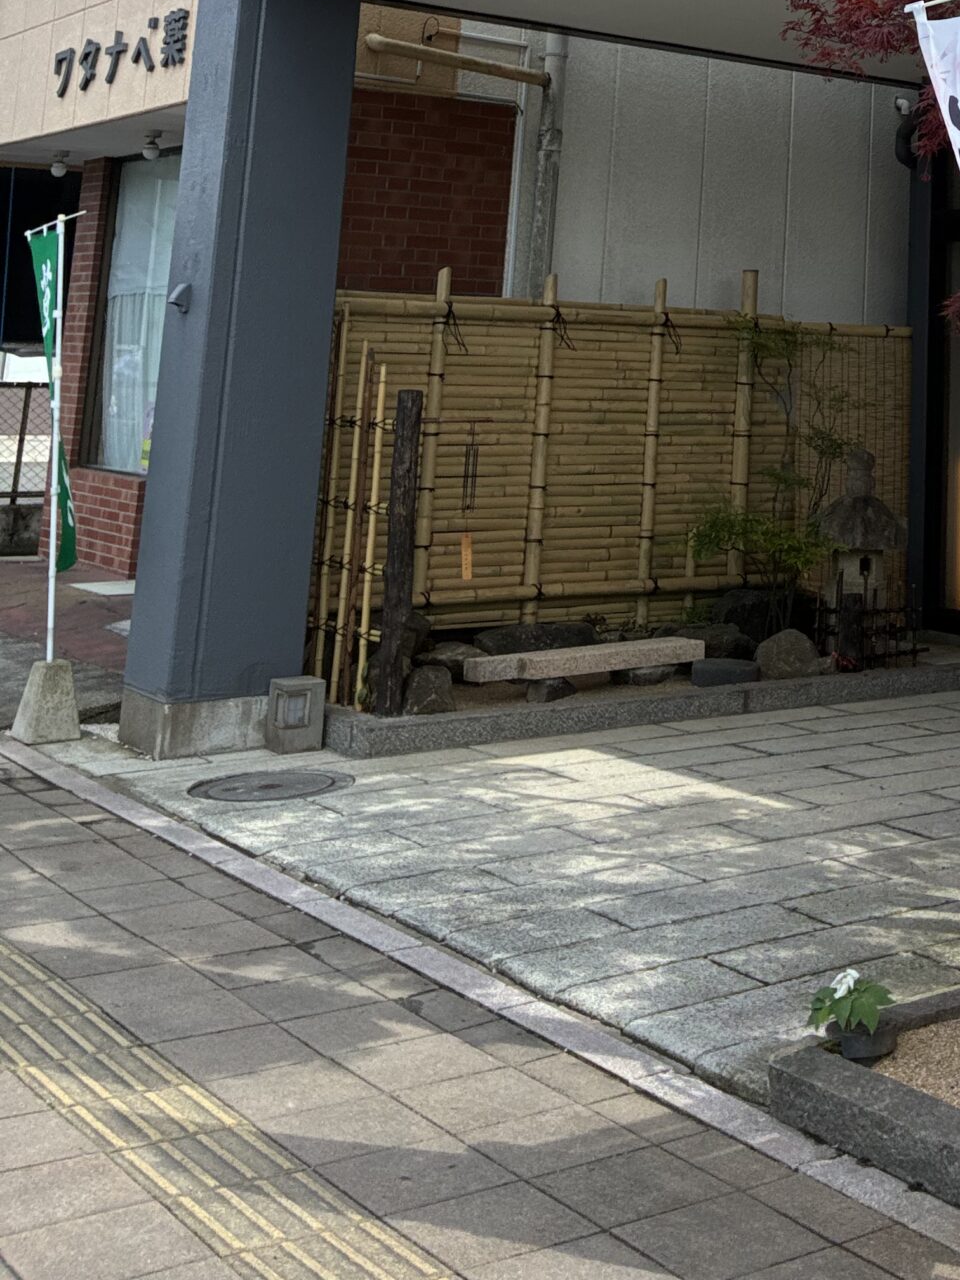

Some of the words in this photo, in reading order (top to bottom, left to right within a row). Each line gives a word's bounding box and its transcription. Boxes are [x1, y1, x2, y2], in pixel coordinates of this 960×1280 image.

[54, 8, 190, 98] ワタナベ薬
